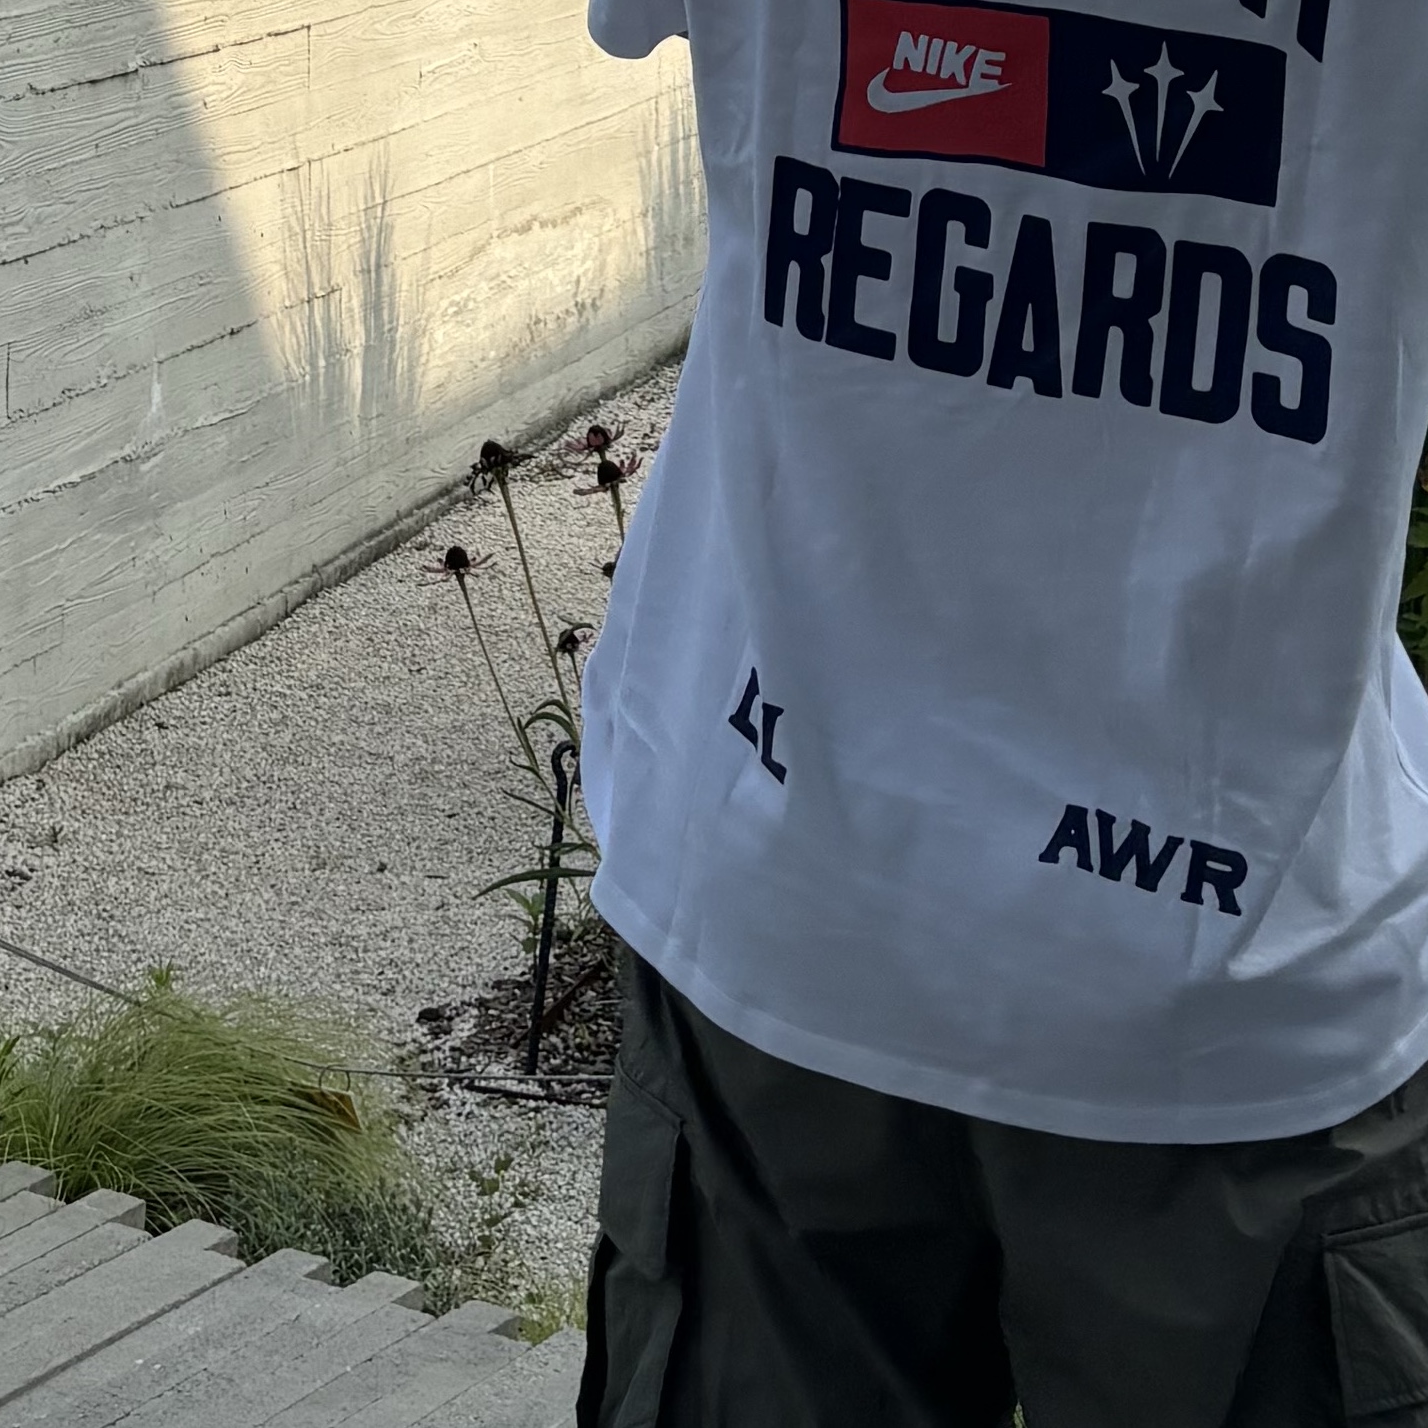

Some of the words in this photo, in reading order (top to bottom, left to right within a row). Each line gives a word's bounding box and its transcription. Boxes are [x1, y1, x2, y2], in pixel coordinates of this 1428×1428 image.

[892, 30, 1007, 90] NIKE
[763, 154, 1338, 445] REGARDS
[1037, 803, 1249, 917] AWR
